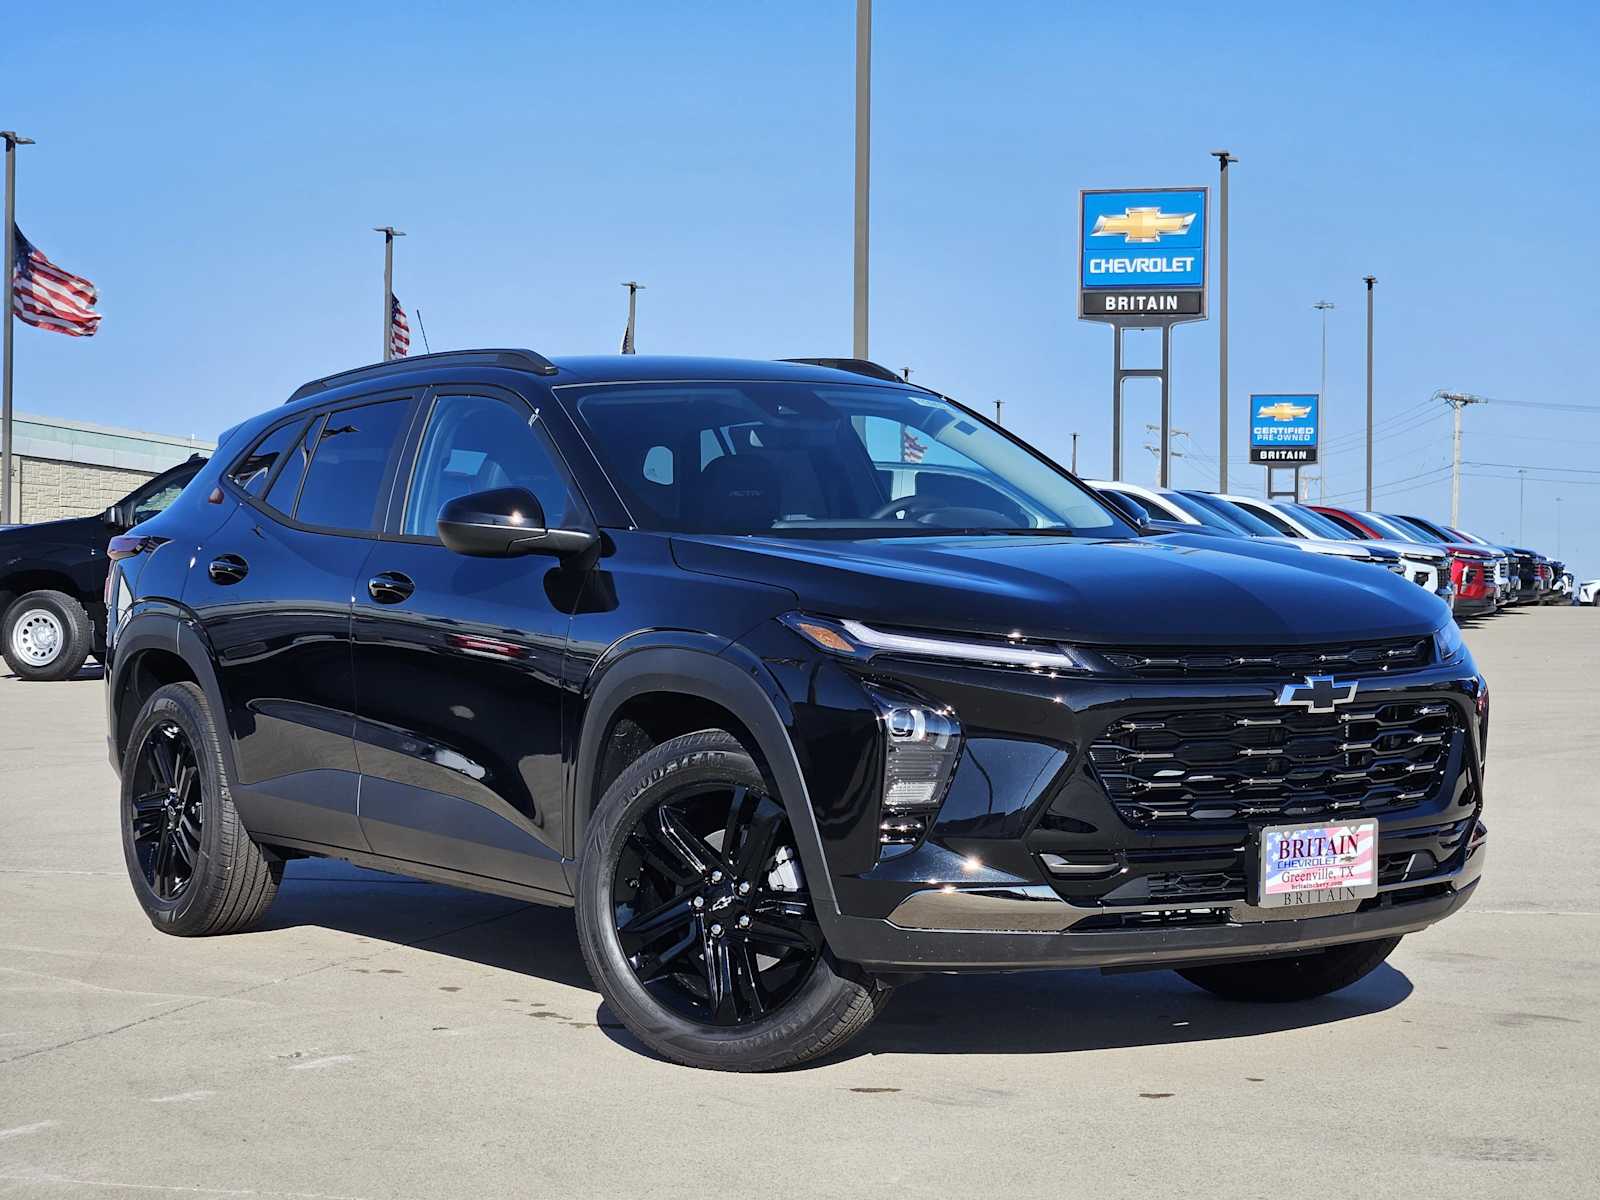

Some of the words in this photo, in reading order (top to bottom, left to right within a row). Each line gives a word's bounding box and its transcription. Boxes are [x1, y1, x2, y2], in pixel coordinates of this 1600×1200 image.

[1089, 257, 1195, 273] CHEVROLET
[1105, 295, 1177, 310] BRITAIN
[1260, 450, 1306, 460] BRITAIN
[1279, 834, 1359, 860] BRITAIN
[1277, 856, 1337, 869] CHEVROLET
[1281, 867, 1336, 883] Greenville,
[1341, 865, 1354, 878] TX
[1284, 886, 1355, 906] BRITAIN
